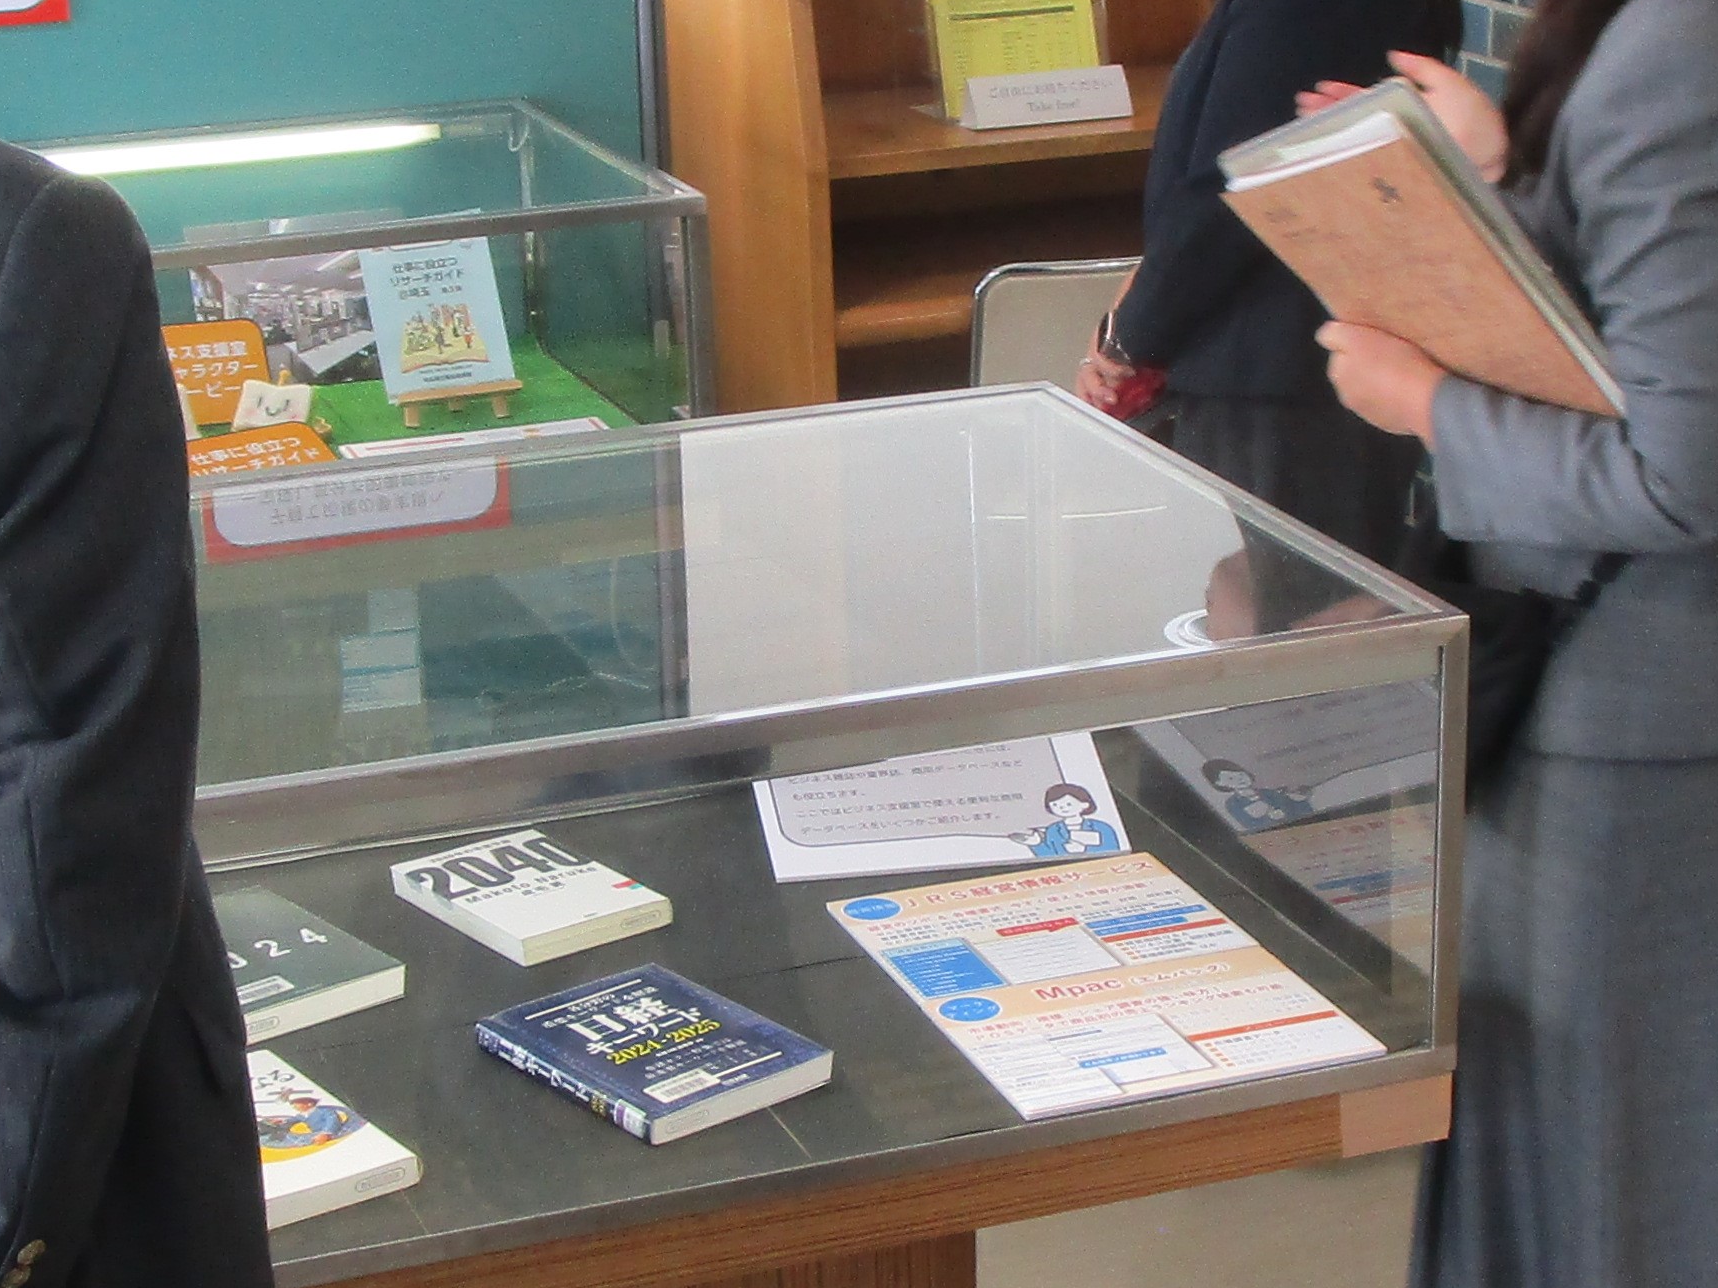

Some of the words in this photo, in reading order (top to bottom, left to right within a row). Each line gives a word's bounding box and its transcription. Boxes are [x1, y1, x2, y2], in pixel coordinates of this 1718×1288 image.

[190, 437, 301, 466] 仕事に役立つ
[406, 836, 596, 902] 2040
[1034, 976, 1122, 1002] Mpac
[567, 997, 670, 1042] 日経
[586, 1007, 702, 1056] キーワード
